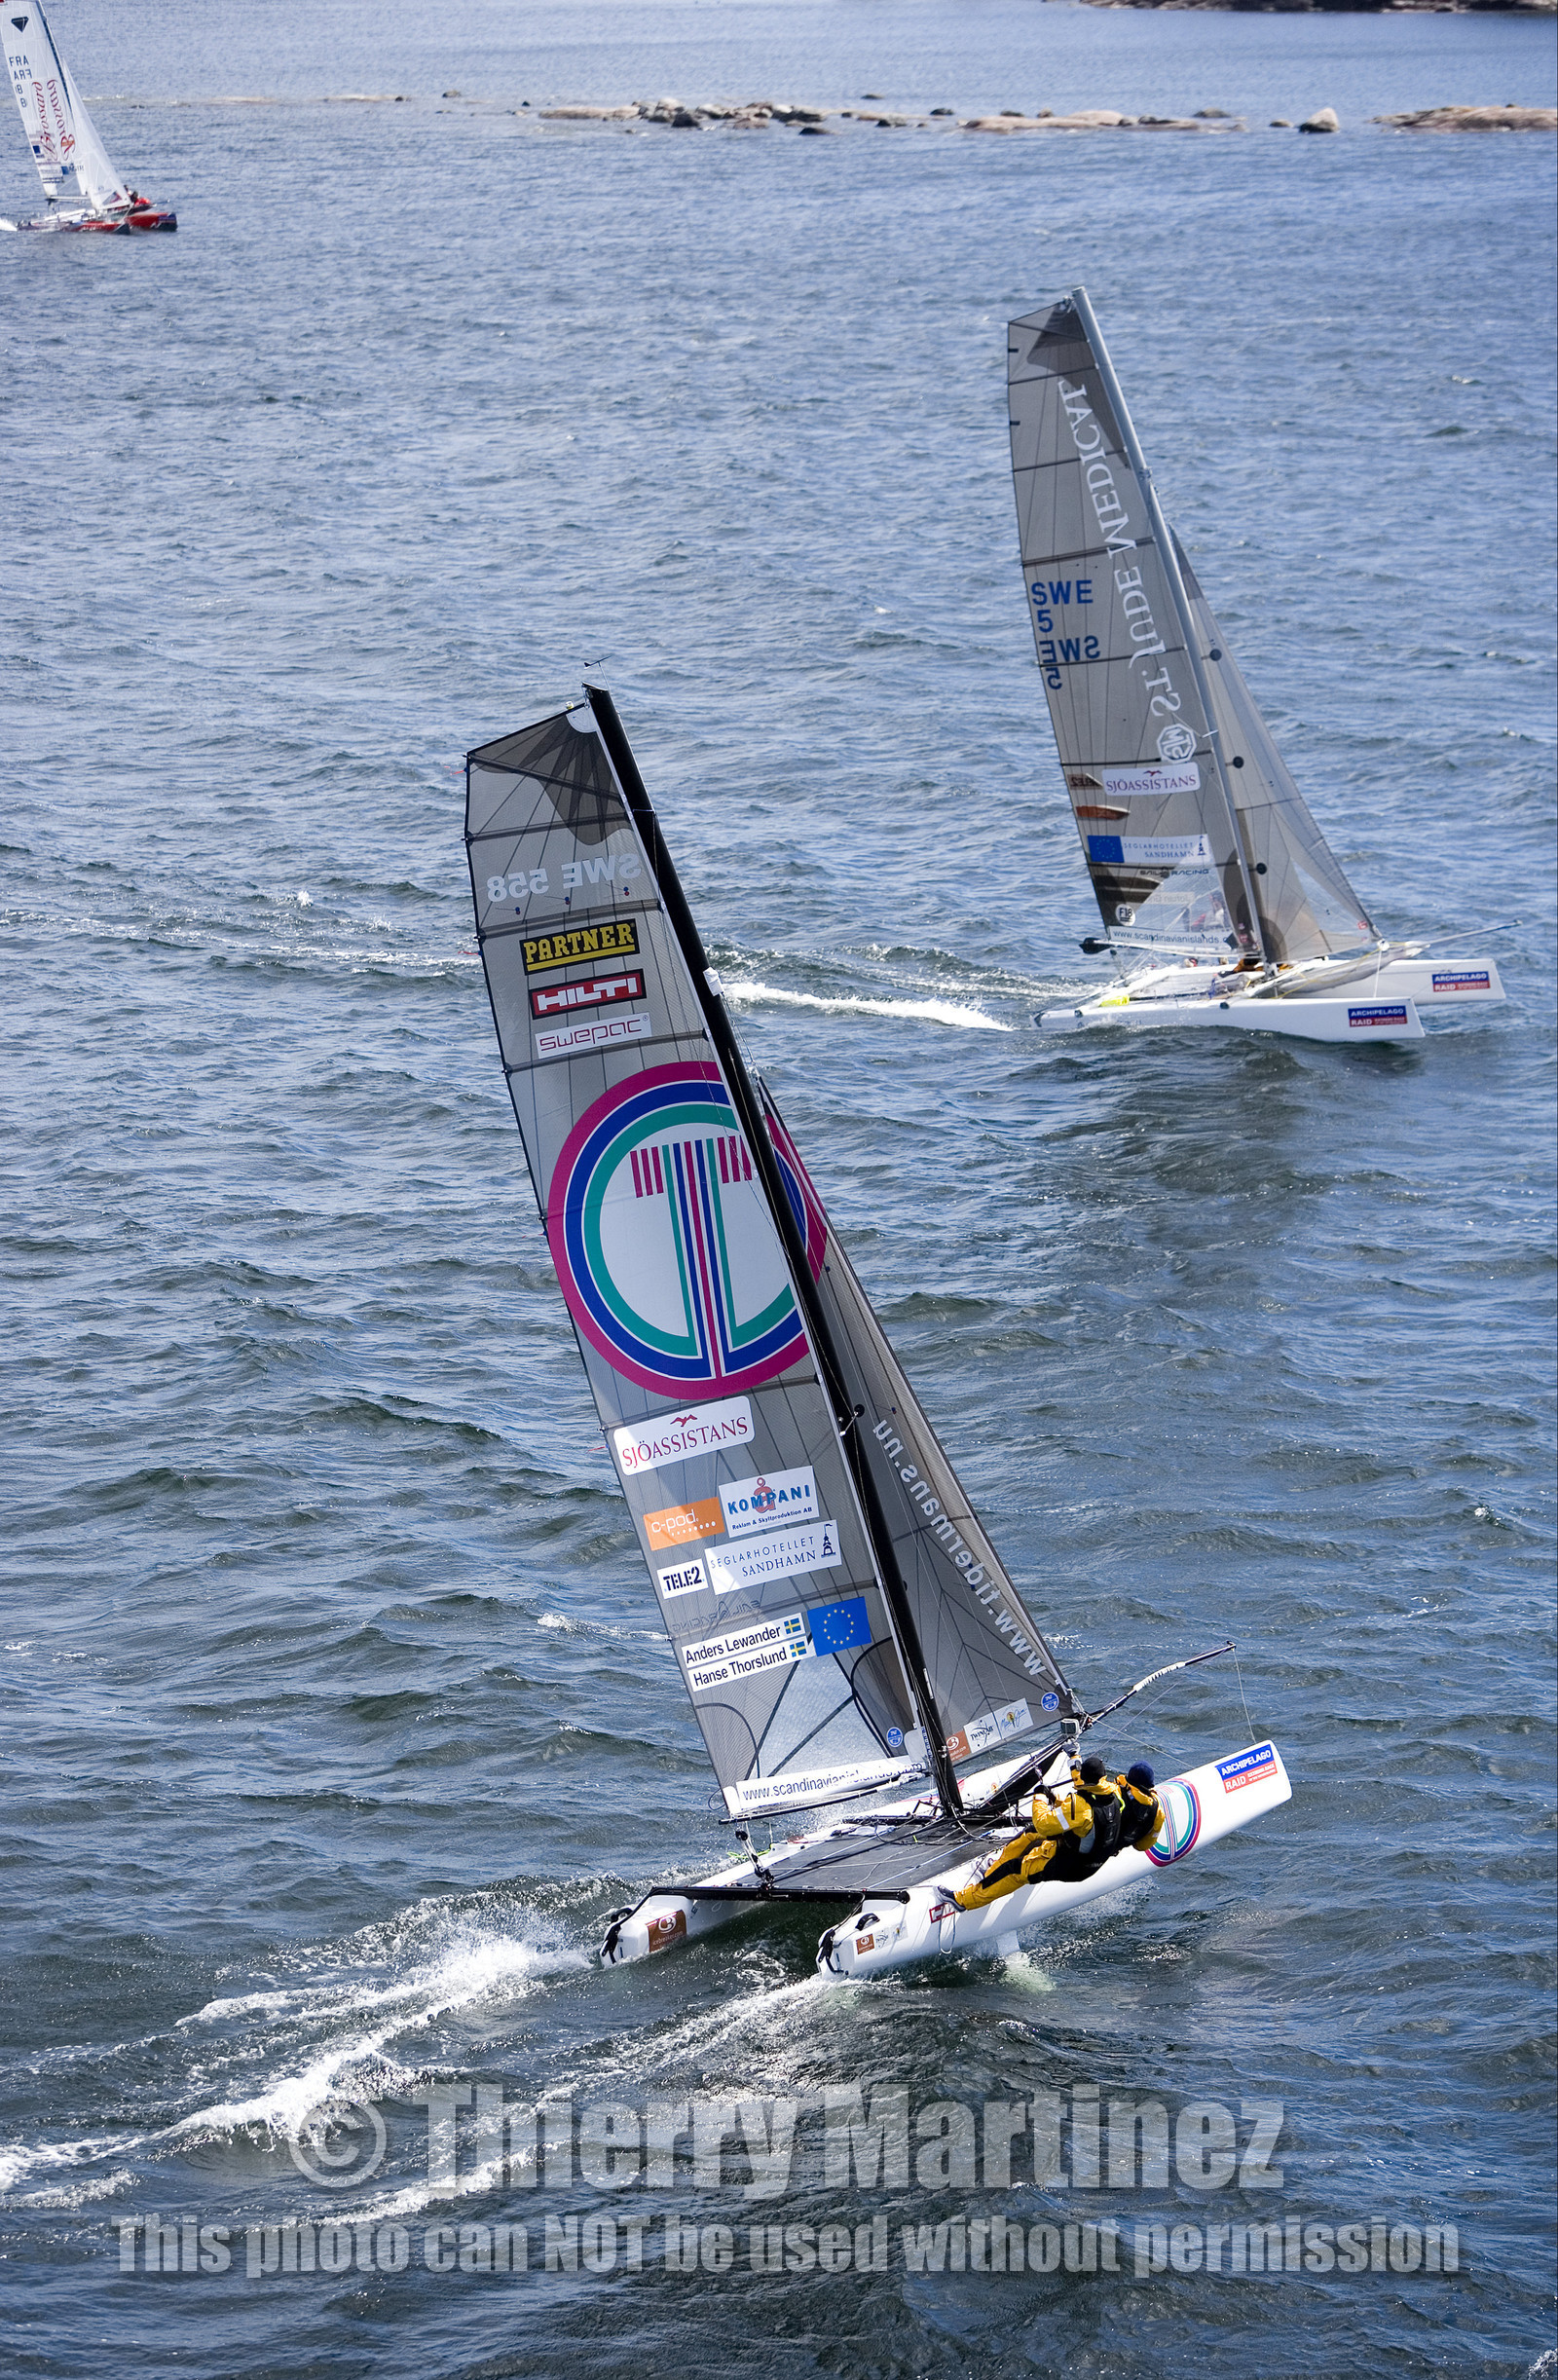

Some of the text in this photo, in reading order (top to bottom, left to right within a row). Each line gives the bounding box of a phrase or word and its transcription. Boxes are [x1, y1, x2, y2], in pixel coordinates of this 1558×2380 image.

[9, 55, 29, 66] FRA
[1031, 579, 1094, 606] SWE
[1037, 610, 1054, 633] 5
[1106, 775, 1197, 793] SJÖASSISTANS
[524, 922, 635, 963] PARTNER
[1434, 974, 1487, 983] ARCHIPELAGO
[538, 977, 638, 1012] HILTI
[1351, 1008, 1404, 1018] ARCHIPELAGO
[621, 1416, 748, 1469] SJÖASSISTANS
[727, 1484, 811, 1515] KOMPANI
[732, 1521, 751, 1530] Reklam
[710, 1536, 814, 1570] SEGLARHOTELLET
[742, 1549, 817, 1578] SANDHAMN
[662, 1566, 703, 1592] TELE2
[686, 1624, 781, 1664] Anders Lewander
[692, 1648, 788, 1687] Hanse Thorslund
[1221, 1750, 1272, 1775] ARCHIPELAGO
[1225, 1775, 1246, 1790] RAID
